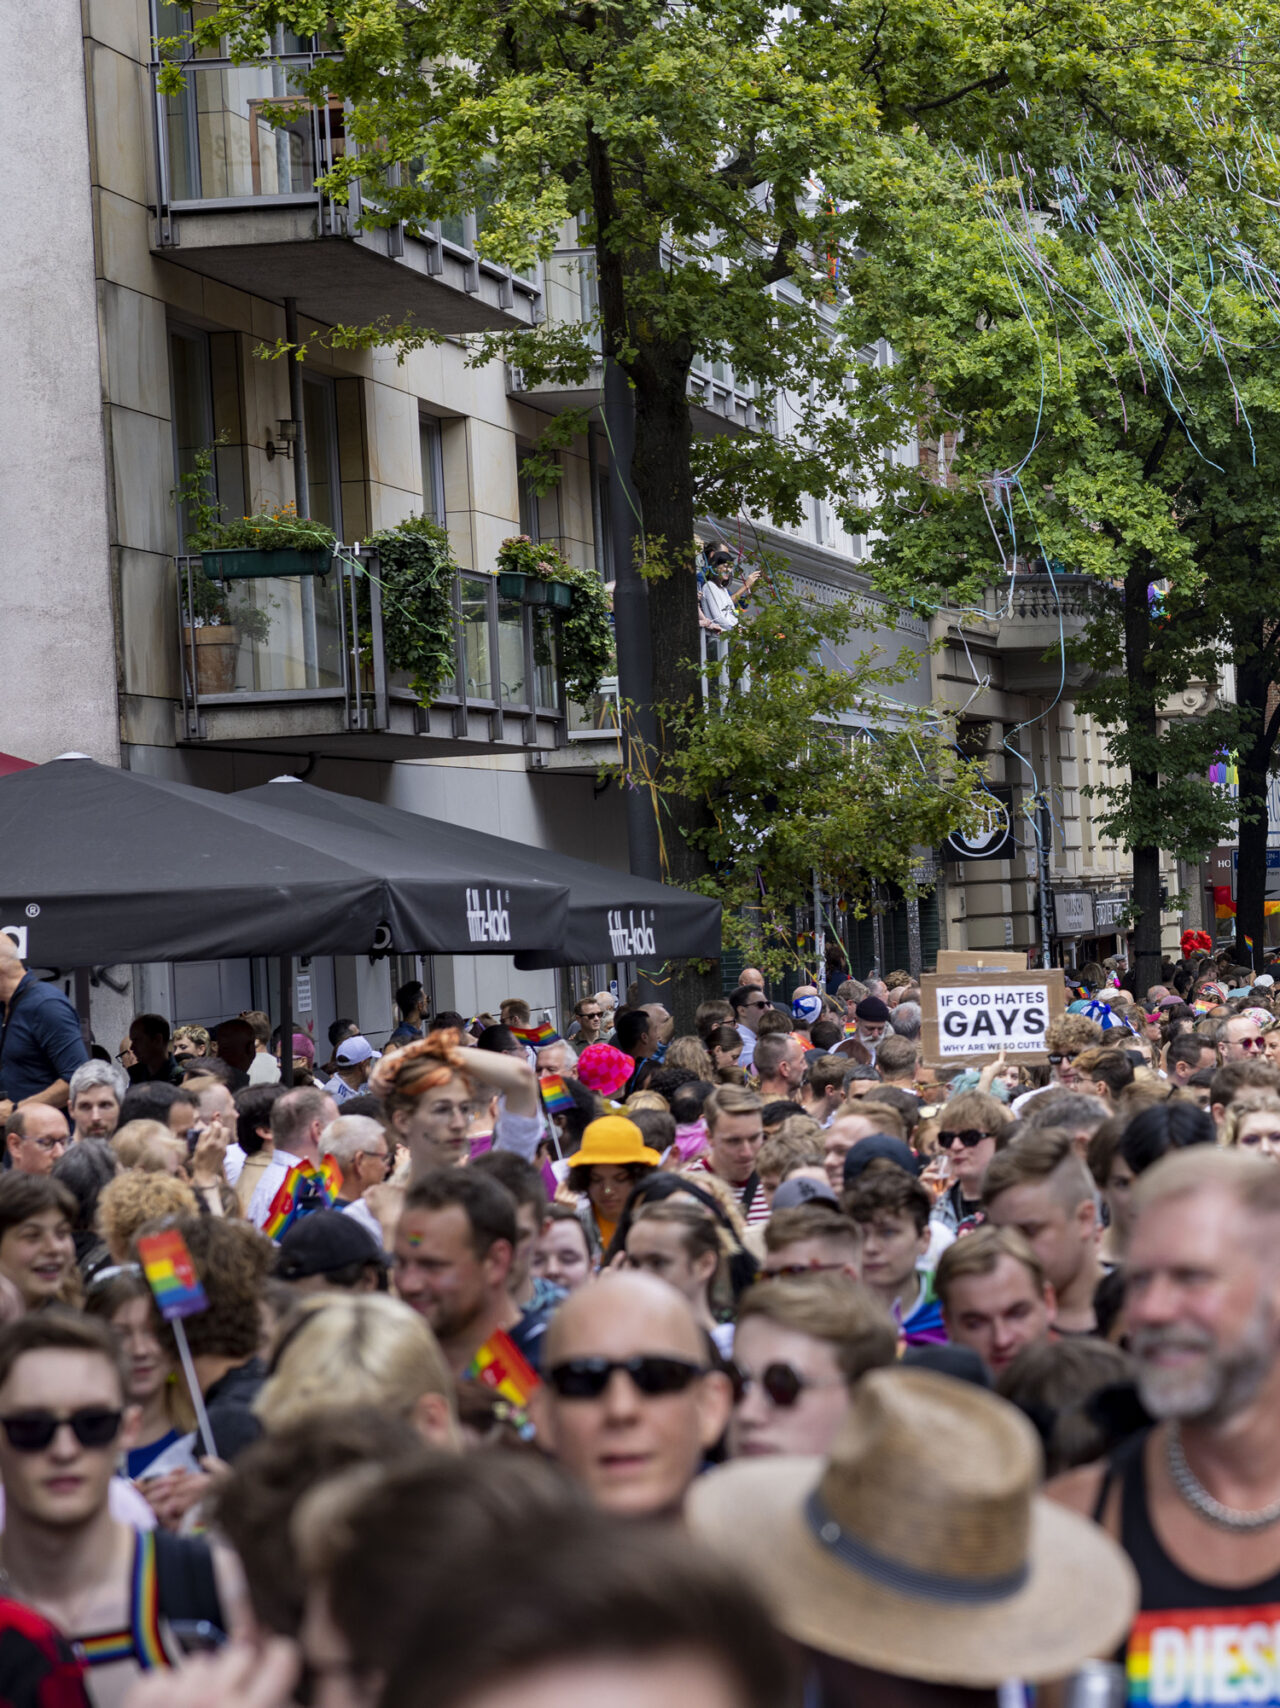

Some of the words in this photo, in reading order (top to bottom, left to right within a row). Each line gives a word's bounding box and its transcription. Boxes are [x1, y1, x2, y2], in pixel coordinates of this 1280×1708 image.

[466, 887, 511, 942] fritz-kola
[608, 909, 656, 957] fritz-kola
[941, 995, 954, 1007] IF
[958, 993, 991, 1007] GOD
[994, 991, 1045, 1005] HATES
[943, 1007, 1045, 1037] GAYS
[943, 1044, 965, 1052] WHY
[967, 1043, 985, 1051] ARE
[987, 1042, 1002, 1050] WE
[1003, 1042, 1016, 1050] SO
